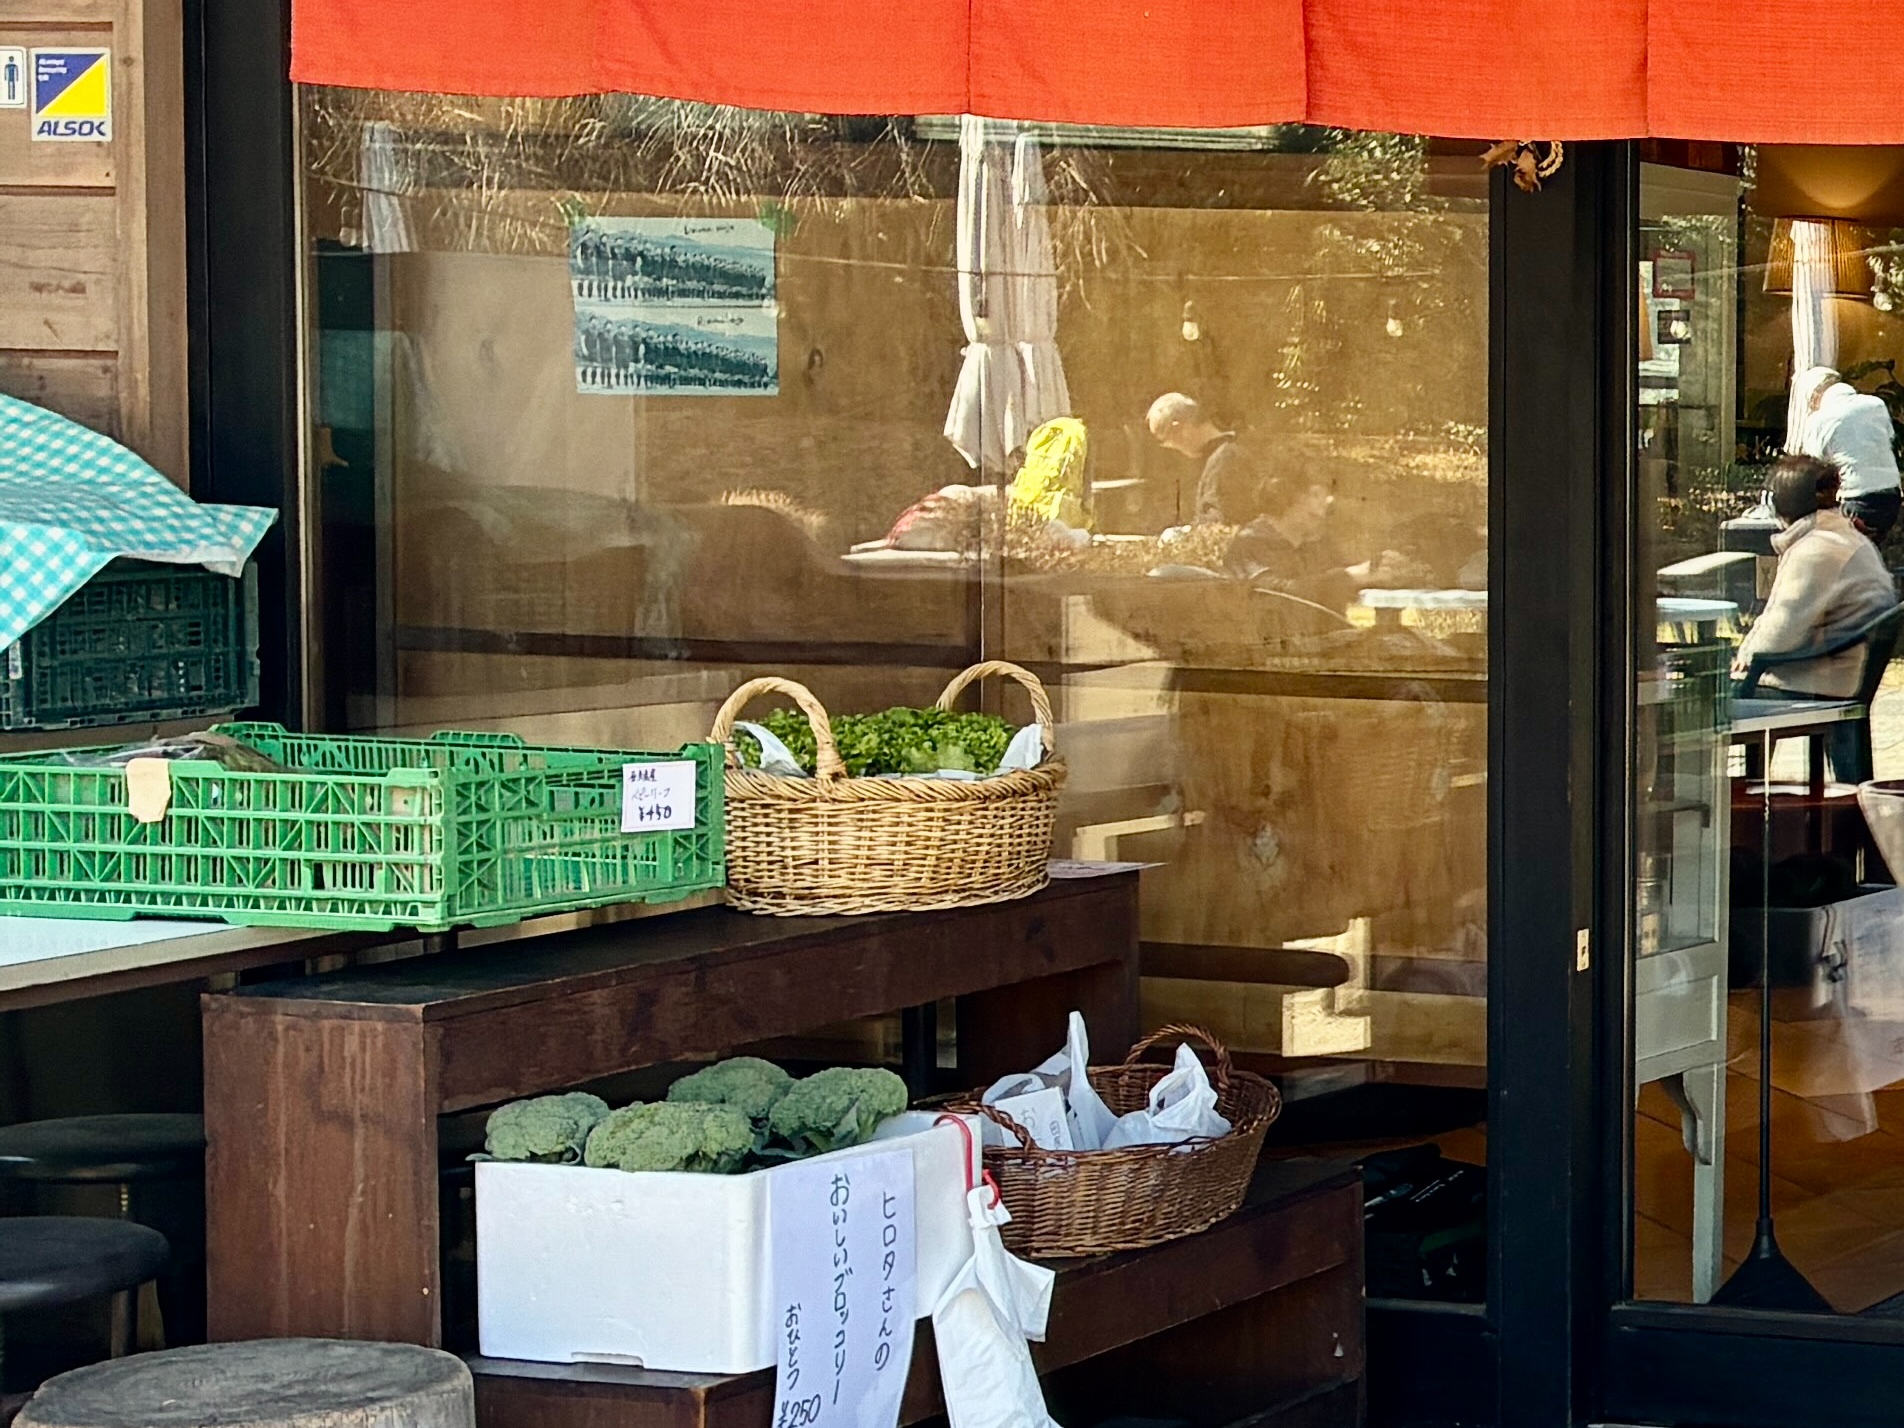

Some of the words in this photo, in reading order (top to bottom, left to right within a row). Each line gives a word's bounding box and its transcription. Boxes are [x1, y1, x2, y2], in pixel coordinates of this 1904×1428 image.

[37, 120, 107, 137] ALSOK
[638, 803, 672, 822] ¥450
[829, 1173, 855, 1405] おいしいブロッコリー
[874, 1190, 898, 1372] ヒロタさんの
[784, 1302, 802, 1390] おひとつ
